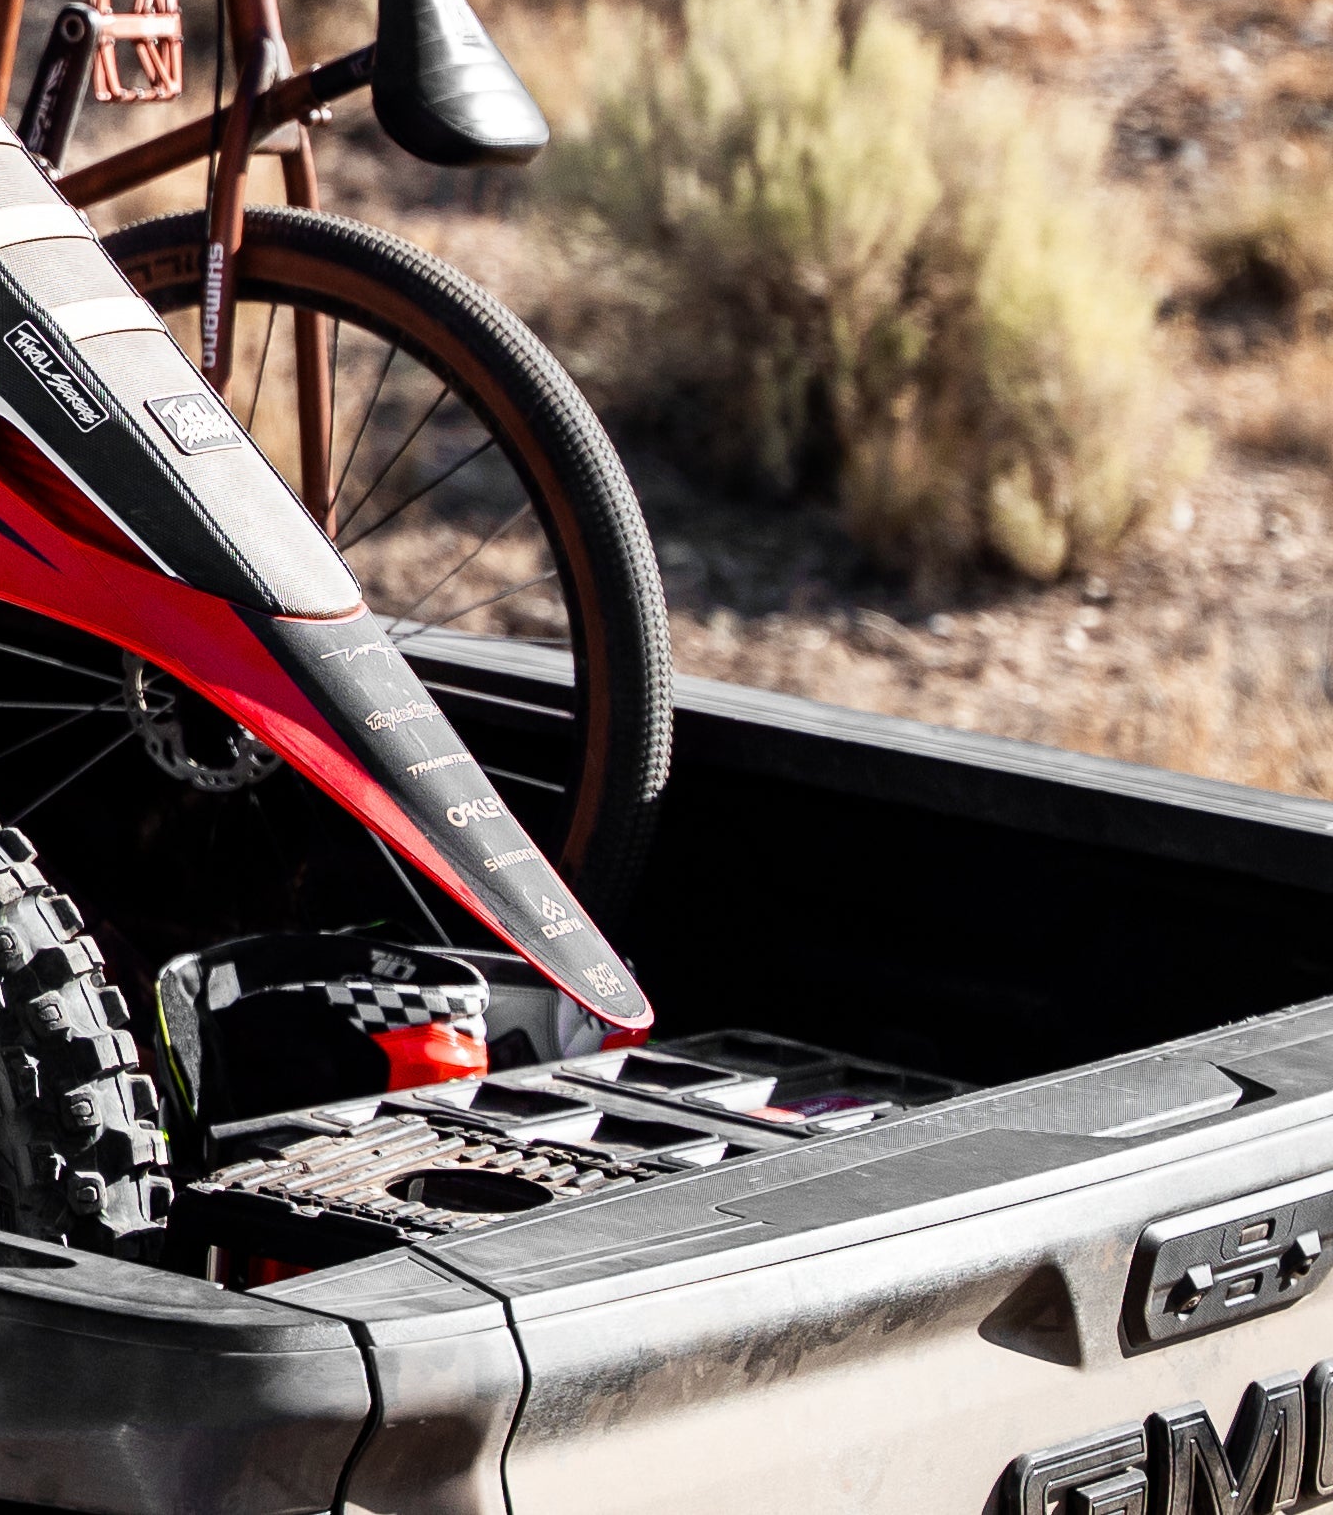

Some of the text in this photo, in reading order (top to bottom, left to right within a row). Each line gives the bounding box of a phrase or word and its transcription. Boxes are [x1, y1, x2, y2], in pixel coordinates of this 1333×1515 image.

[203, 241, 224, 369] SHIMANO
[14, 328, 101, 425] THRILL SEEKERS
[446, 796, 506, 829] OAKLEY
[541, 917, 585, 941] DUBYA
[983, 1358, 1333, 1515] GM
